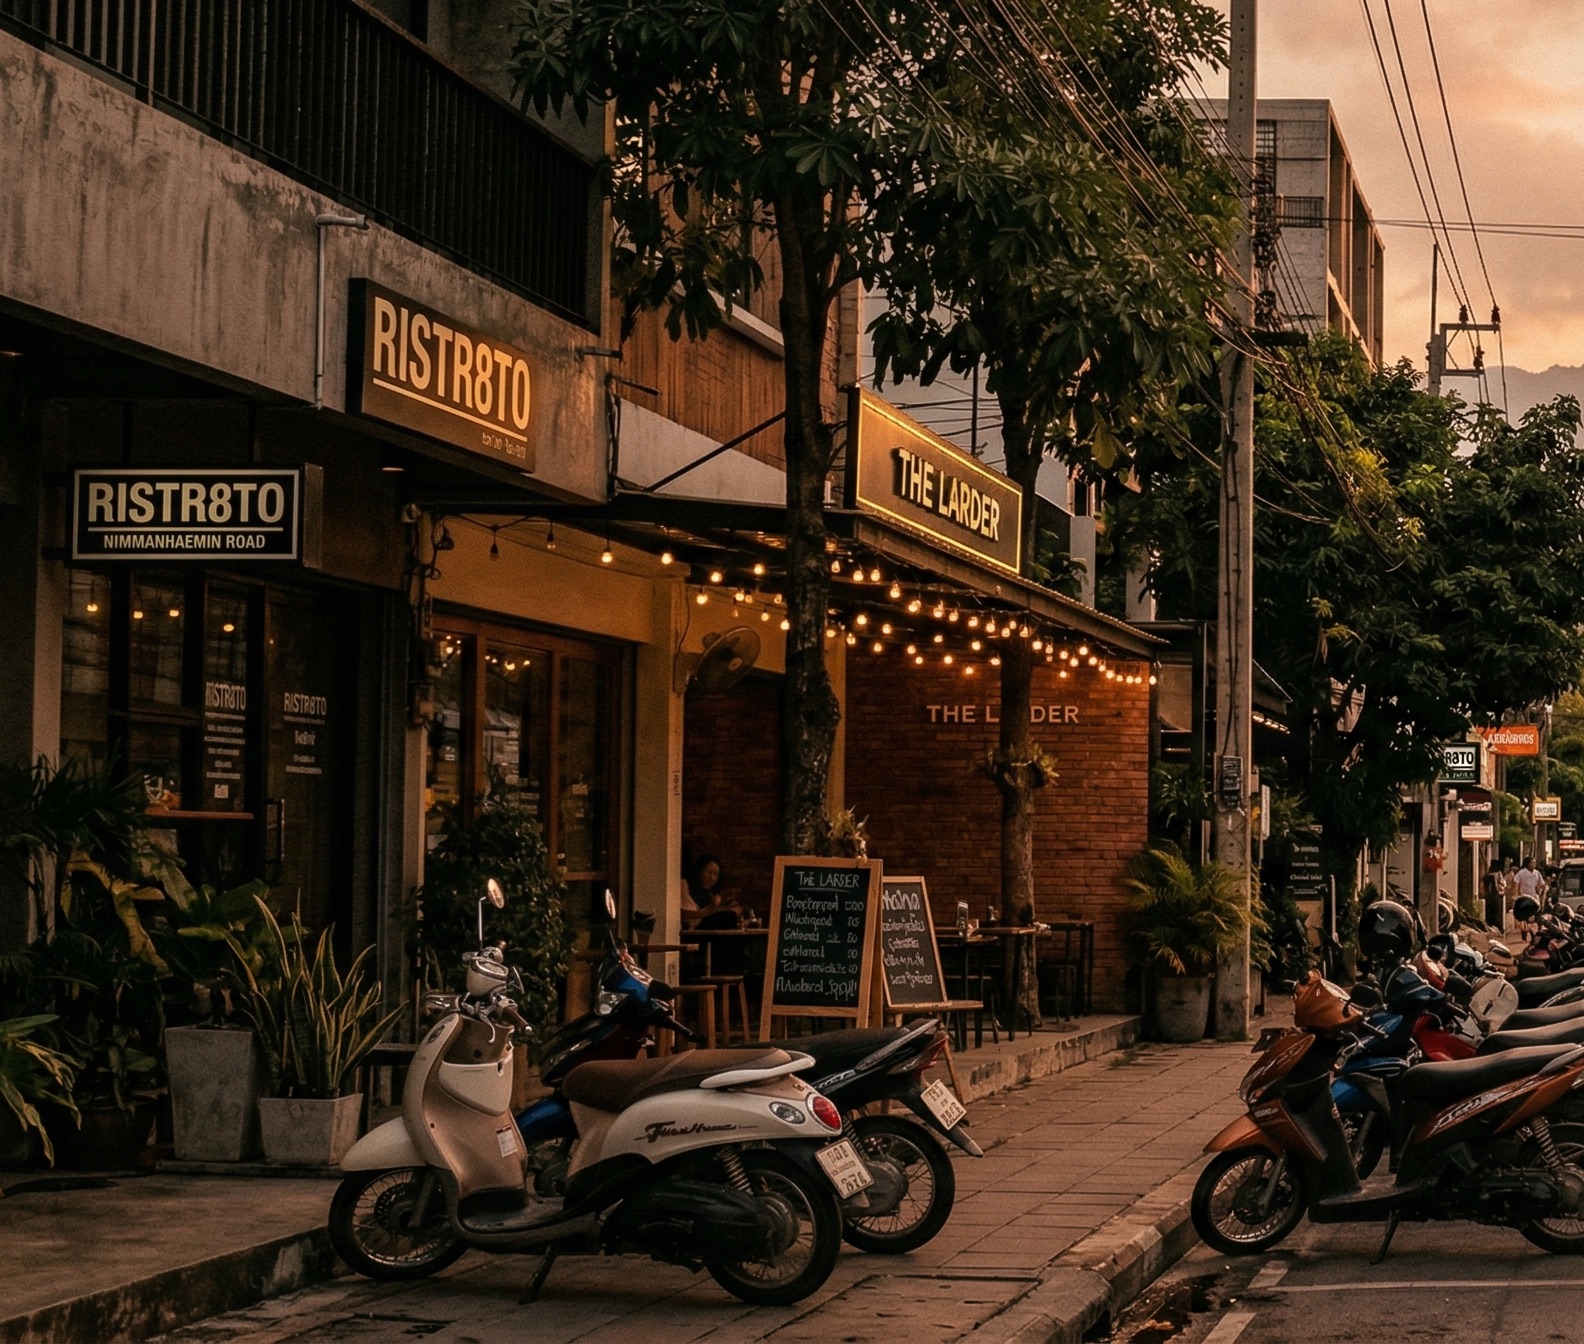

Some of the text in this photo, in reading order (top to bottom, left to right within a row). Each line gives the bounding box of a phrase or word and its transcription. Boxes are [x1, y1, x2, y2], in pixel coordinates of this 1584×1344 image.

[373, 296, 531, 430] RISTR8TO
[88, 482, 285, 523] RISTR8TO
[899, 448, 1000, 541] THE LARDER
[103, 534, 266, 549] NIMMANHAEMIN ROAD
[284, 692, 326, 716] RISTR8TO
[926, 705, 1079, 723] THE LDER
